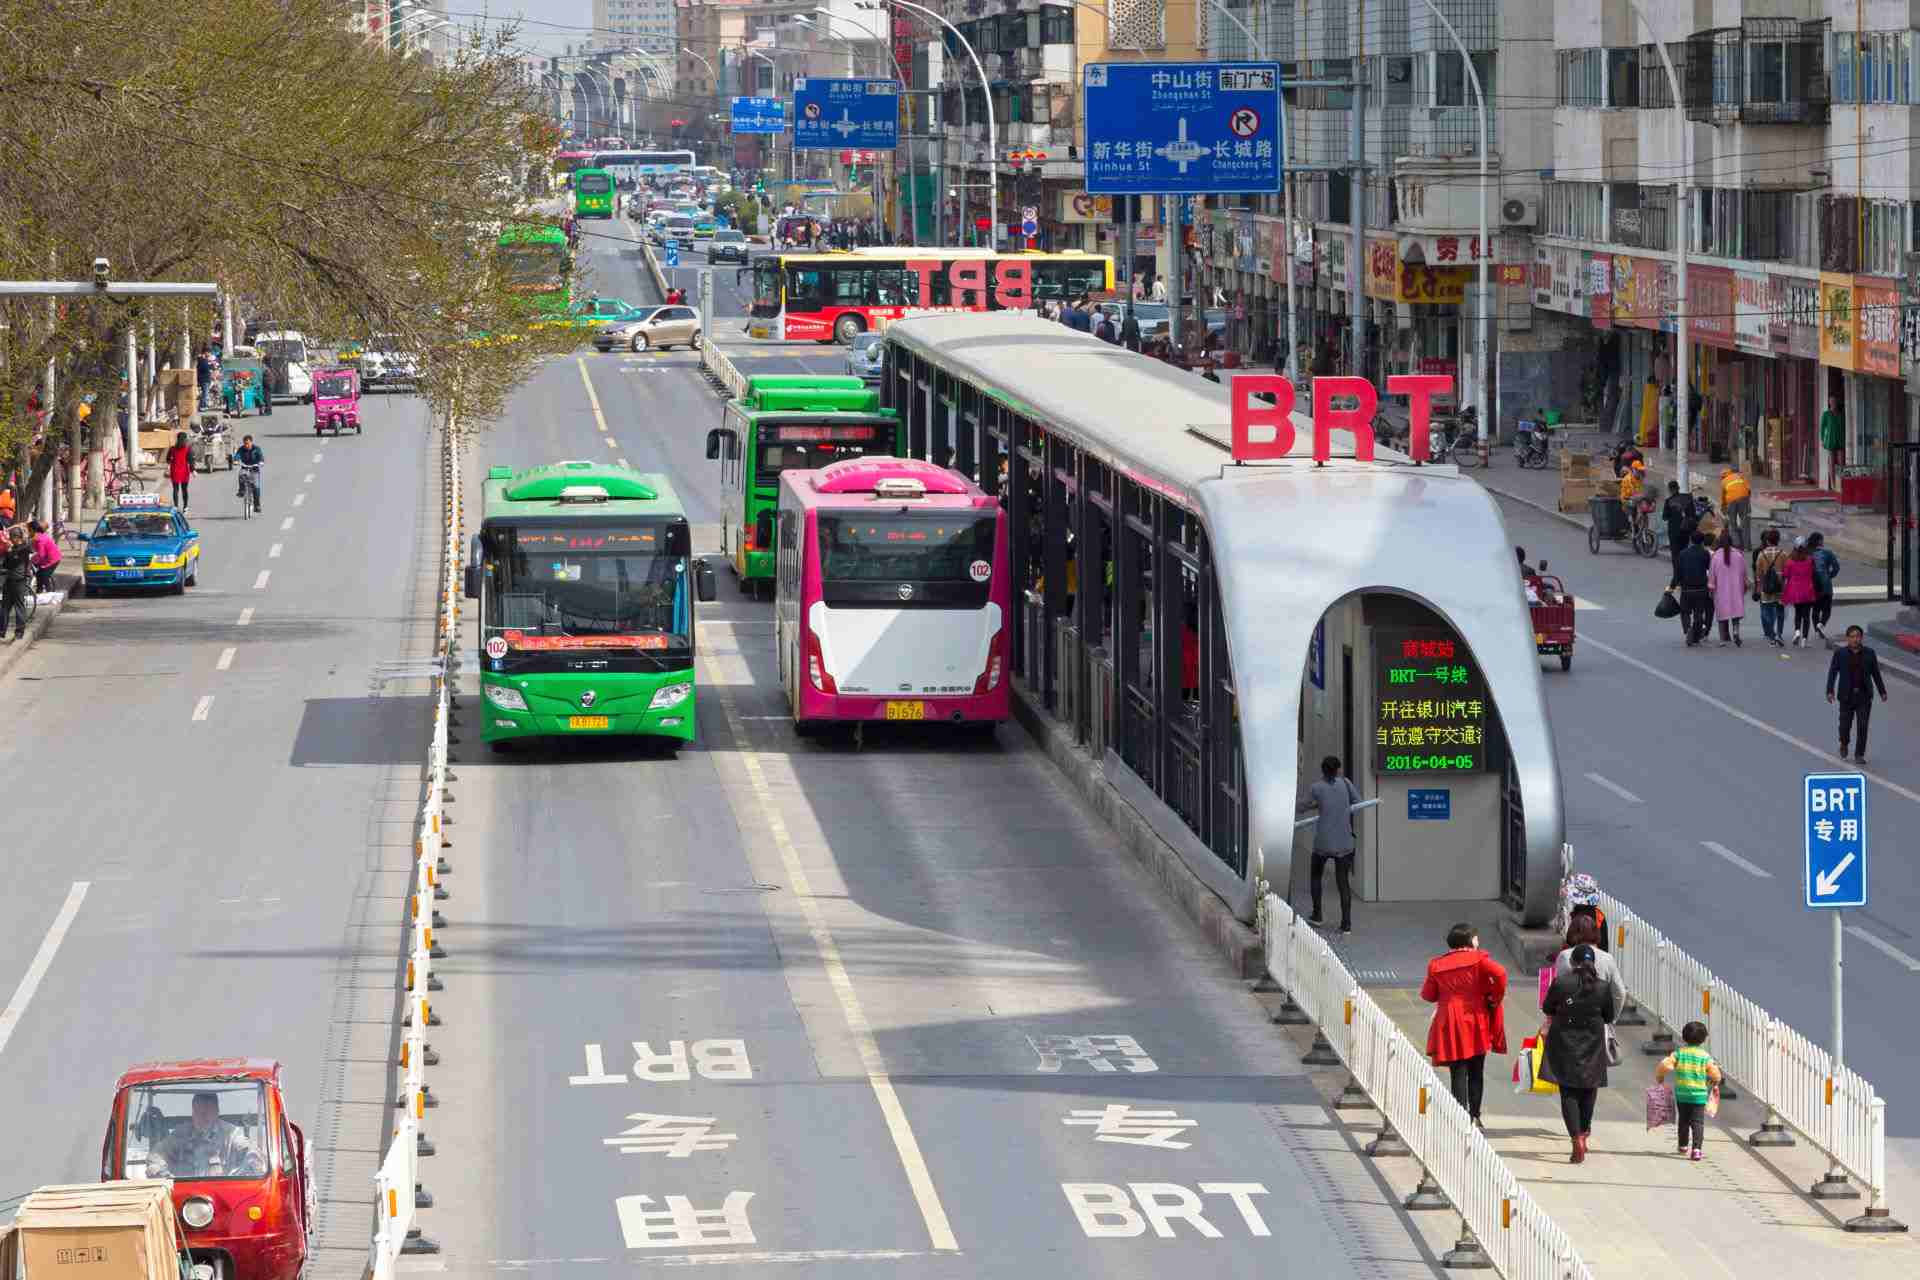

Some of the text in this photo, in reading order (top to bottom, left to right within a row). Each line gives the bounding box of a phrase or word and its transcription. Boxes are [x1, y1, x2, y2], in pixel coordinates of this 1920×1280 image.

[1151, 70, 1213, 89] 中山街
[1221, 71, 1274, 89] 南门广场
[1152, 90, 1211, 101] Zhongshan St
[1093, 141, 1153, 160] 新华街
[1212, 140, 1273, 159] 长城路
[1092, 160, 1151, 171] Xinhua St
[1212, 159, 1259, 170] Changcheng
[1230, 374, 1454, 462] BRT
[971, 564, 989, 576] 102
[487, 641, 506, 653] 102
[1382, 701, 1482, 719] 开往银川汽车
[1386, 755, 1473, 769] 2016-04-05
[1811, 787, 1859, 812] BRT
[1813, 818, 1858, 842] 专用
[568, 1038, 753, 1085] BRT
[1061, 1182, 1273, 1238] BRT
